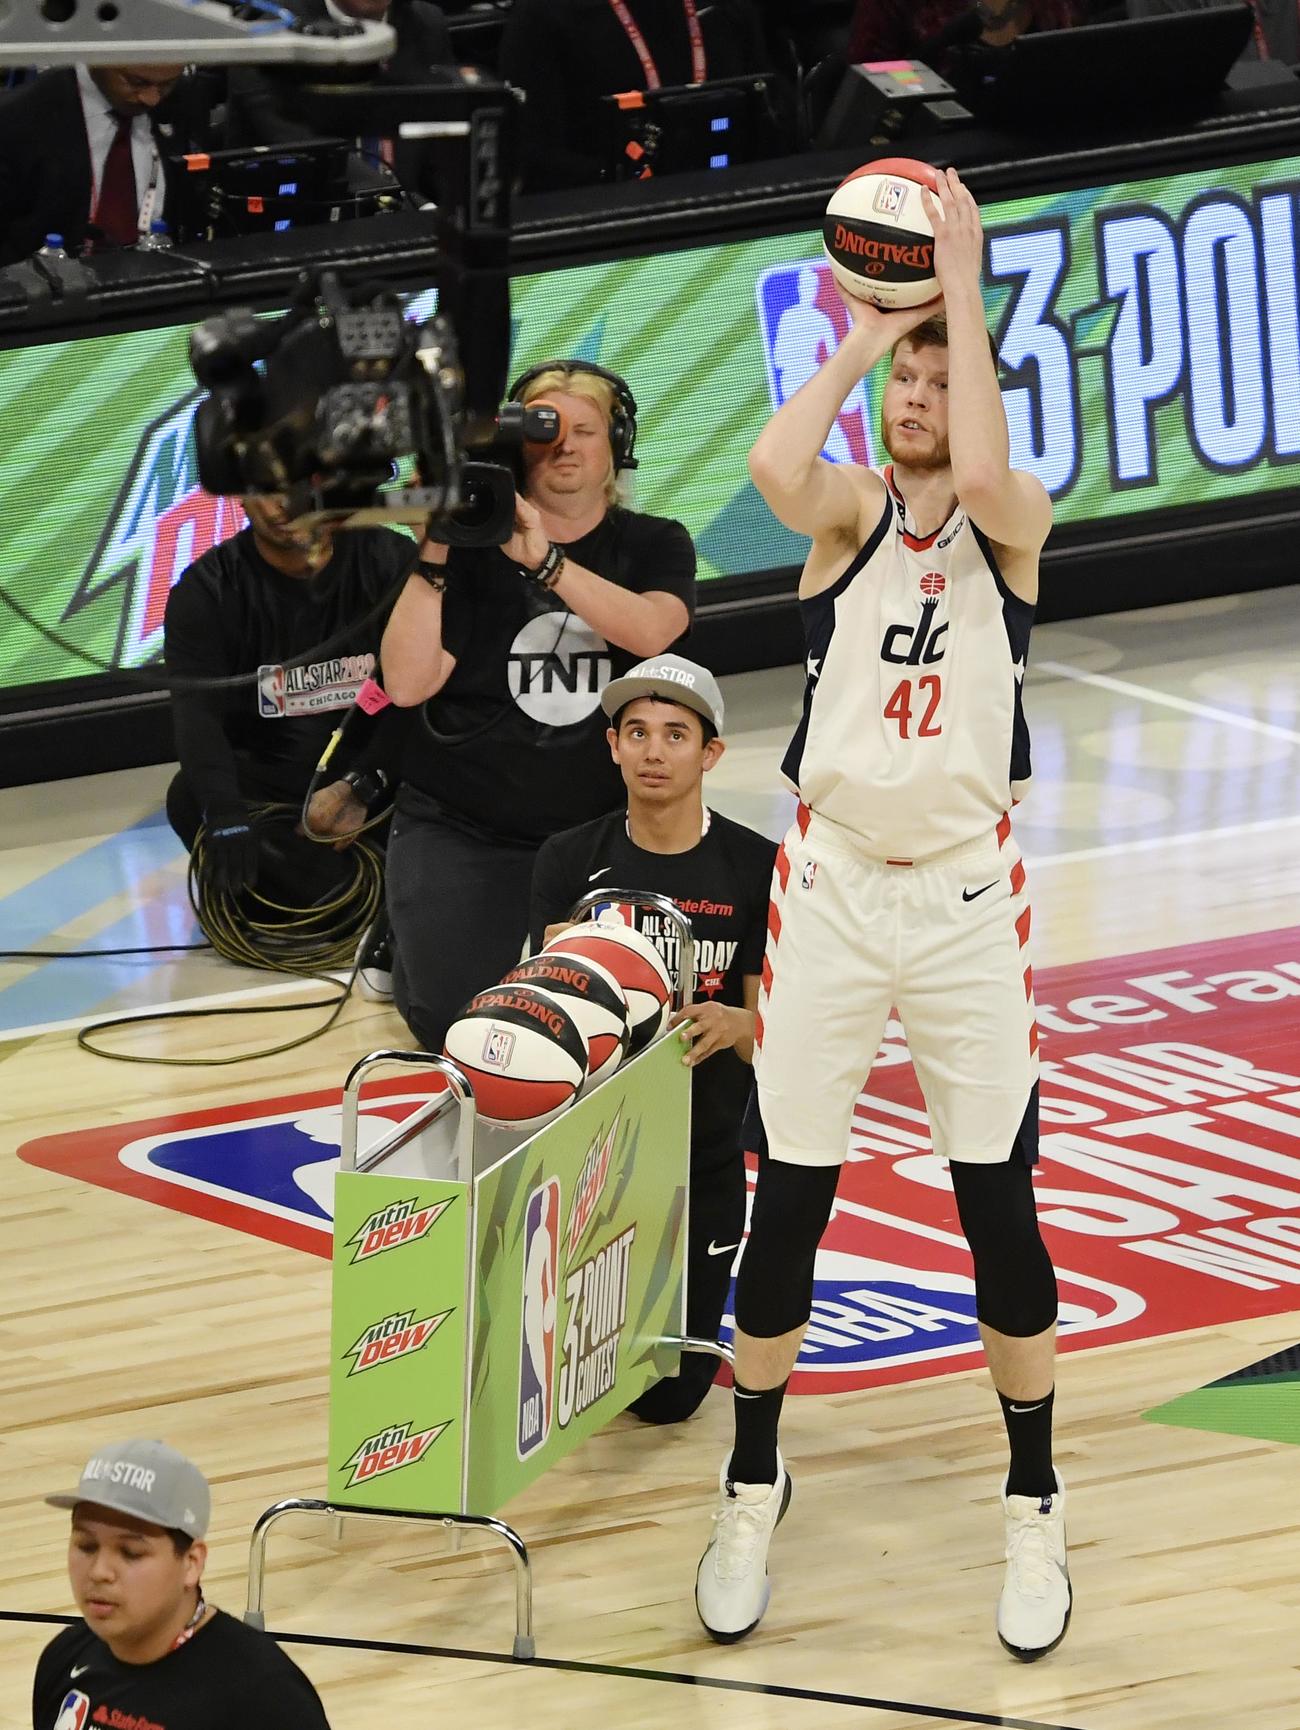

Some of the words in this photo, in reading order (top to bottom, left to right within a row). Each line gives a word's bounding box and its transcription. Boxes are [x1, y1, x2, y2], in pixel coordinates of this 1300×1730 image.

[834, 224, 934, 269] SPALDING
[508, 651, 609, 694] TNT
[309, 691, 356, 707] CHICAGO
[884, 675, 942, 740] 42
[672, 898, 734, 916] ateFarm
[646, 936, 738, 974] ATRDAY
[466, 994, 565, 1036] SPALDING
[579, 1227, 635, 1358] POINT
[575, 1332, 620, 1413] CONTEST
[521, 1393, 540, 1444] NBA
